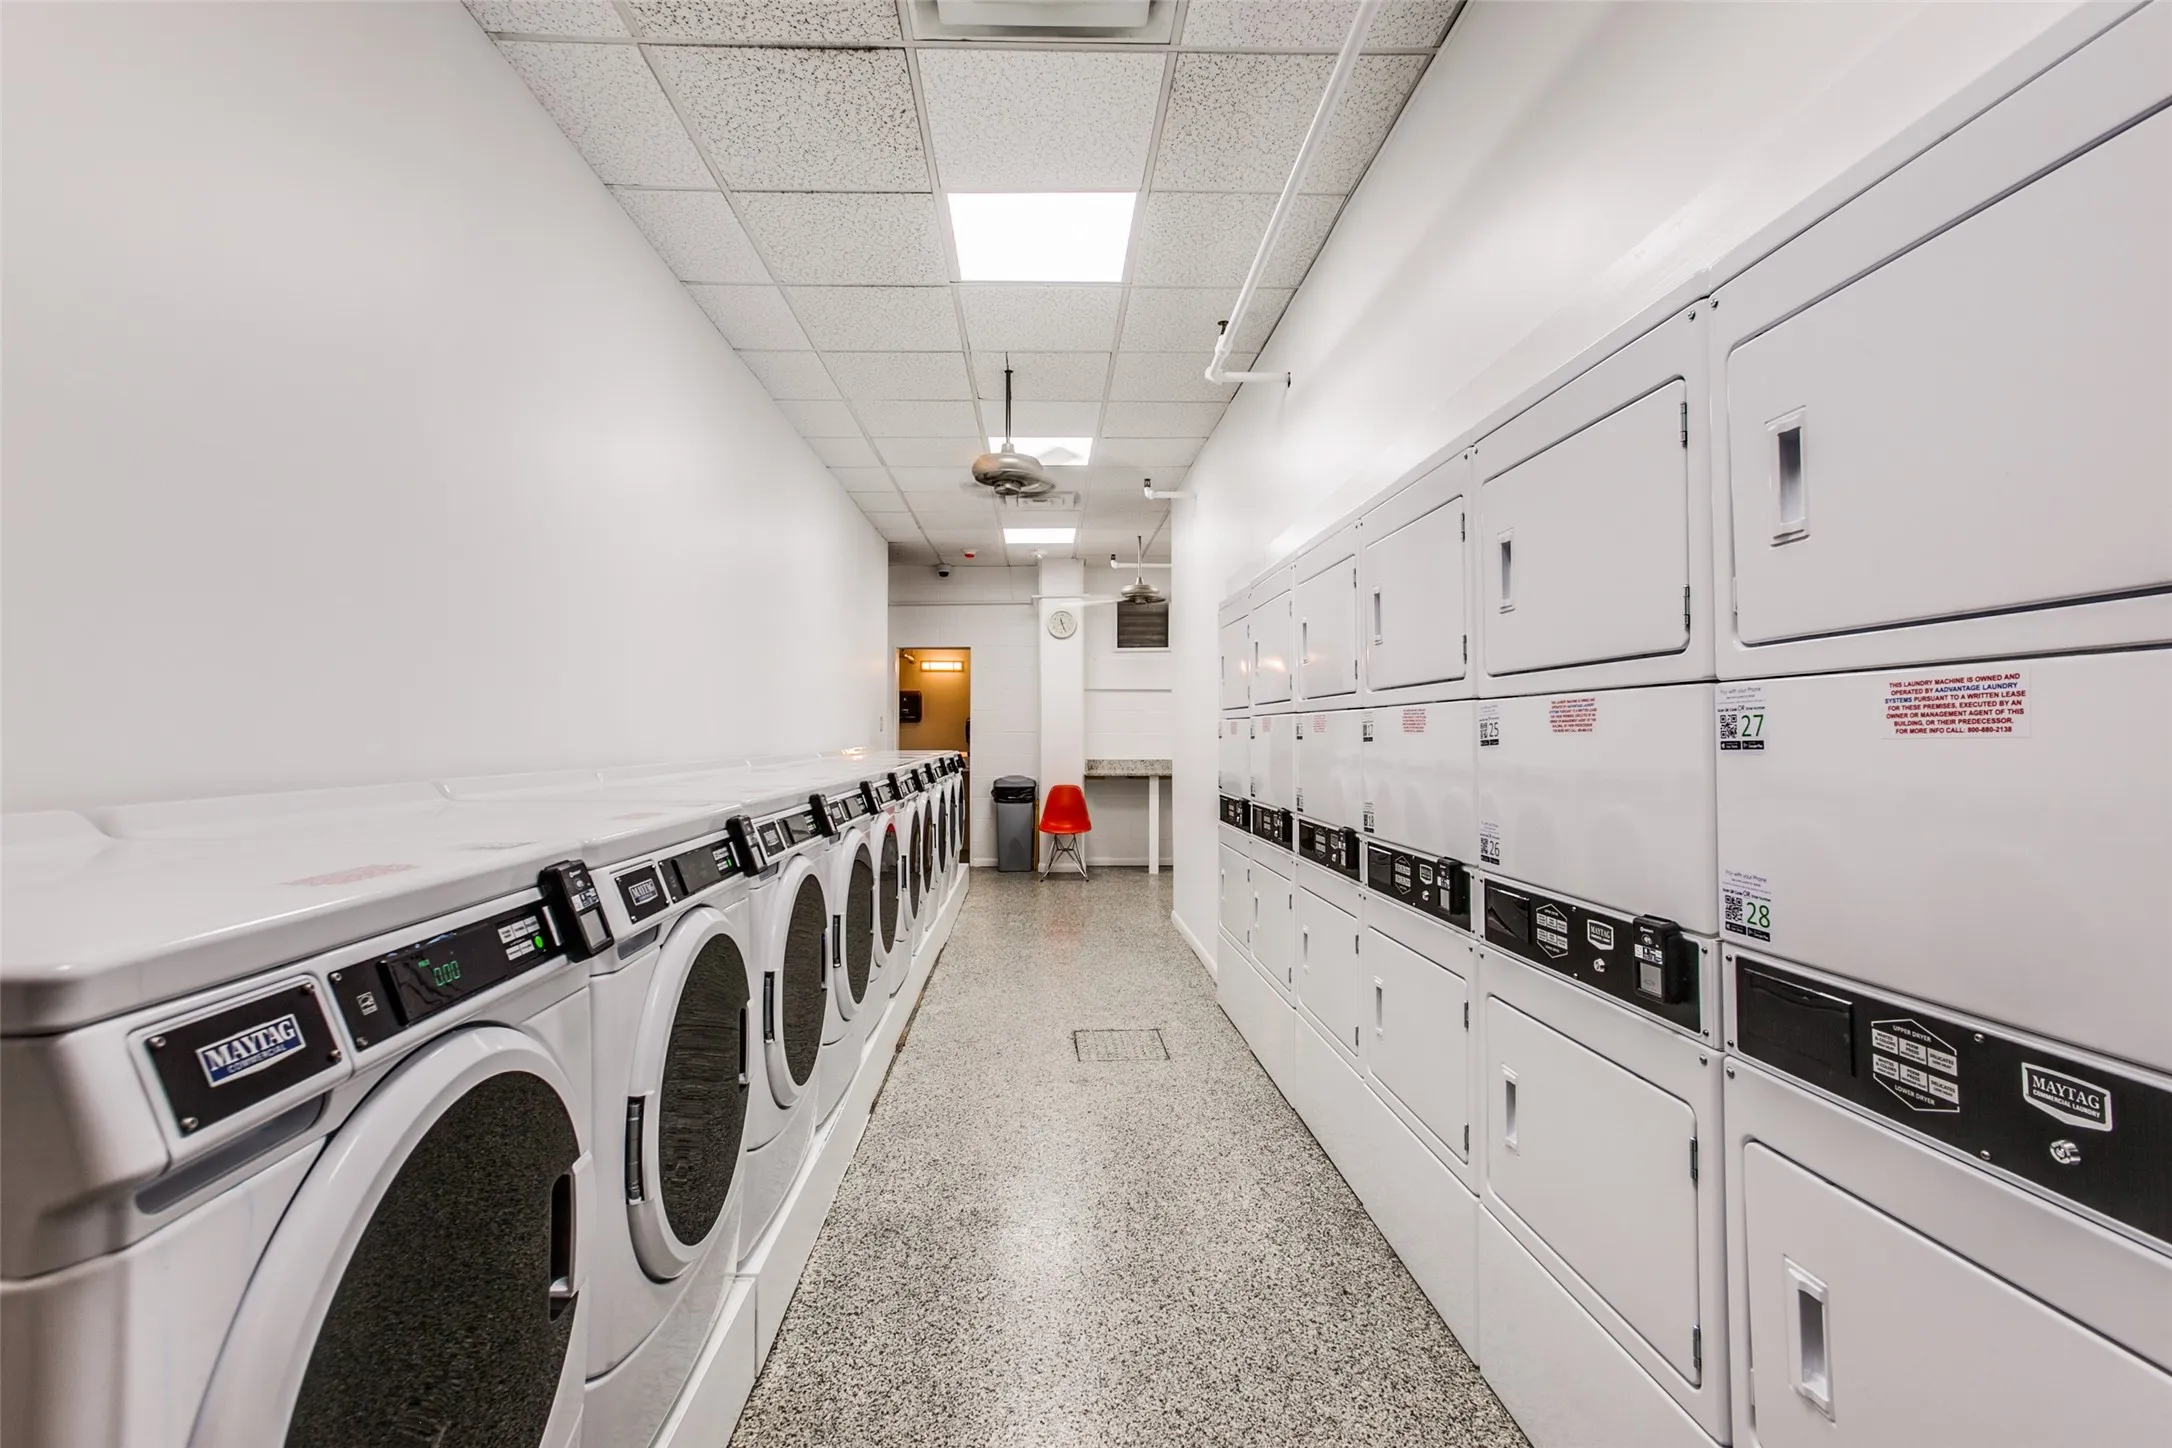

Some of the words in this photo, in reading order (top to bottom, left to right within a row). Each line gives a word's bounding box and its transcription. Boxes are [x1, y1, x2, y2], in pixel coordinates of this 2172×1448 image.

[1891, 688, 1923, 696] OPERATED
[1935, 685, 1980, 693] AADVANTAGE
[1982, 682, 2018, 690] LAUNDRY
[1904, 680, 1933, 688] LAUNDRY
[1975, 674, 2002, 682] OWNED
[1960, 700, 1997, 708] EXECUTED
[1489, 722, 1499, 737] 25
[1742, 714, 1763, 737] 27
[1490, 840, 1499, 856] 26
[1747, 902, 1770, 928] 28
[1893, 1025, 1911, 1036] UPPER
[1912, 1031, 1932, 1042] DRYER
[204, 1020, 296, 1071] MAYTAG
[1930, 1053, 1954, 1065] DELICATES
[1931, 1080, 1956, 1093] DELICATES
[2032, 1075, 2100, 1109] MAYTAG
[1894, 1084, 1915, 1097] LOWER
[1916, 1093, 1935, 1106] DRYER
[2033, 1089, 2071, 1108] COMMERCIAL
[2072, 1103, 2100, 1118] LAUNDRY
